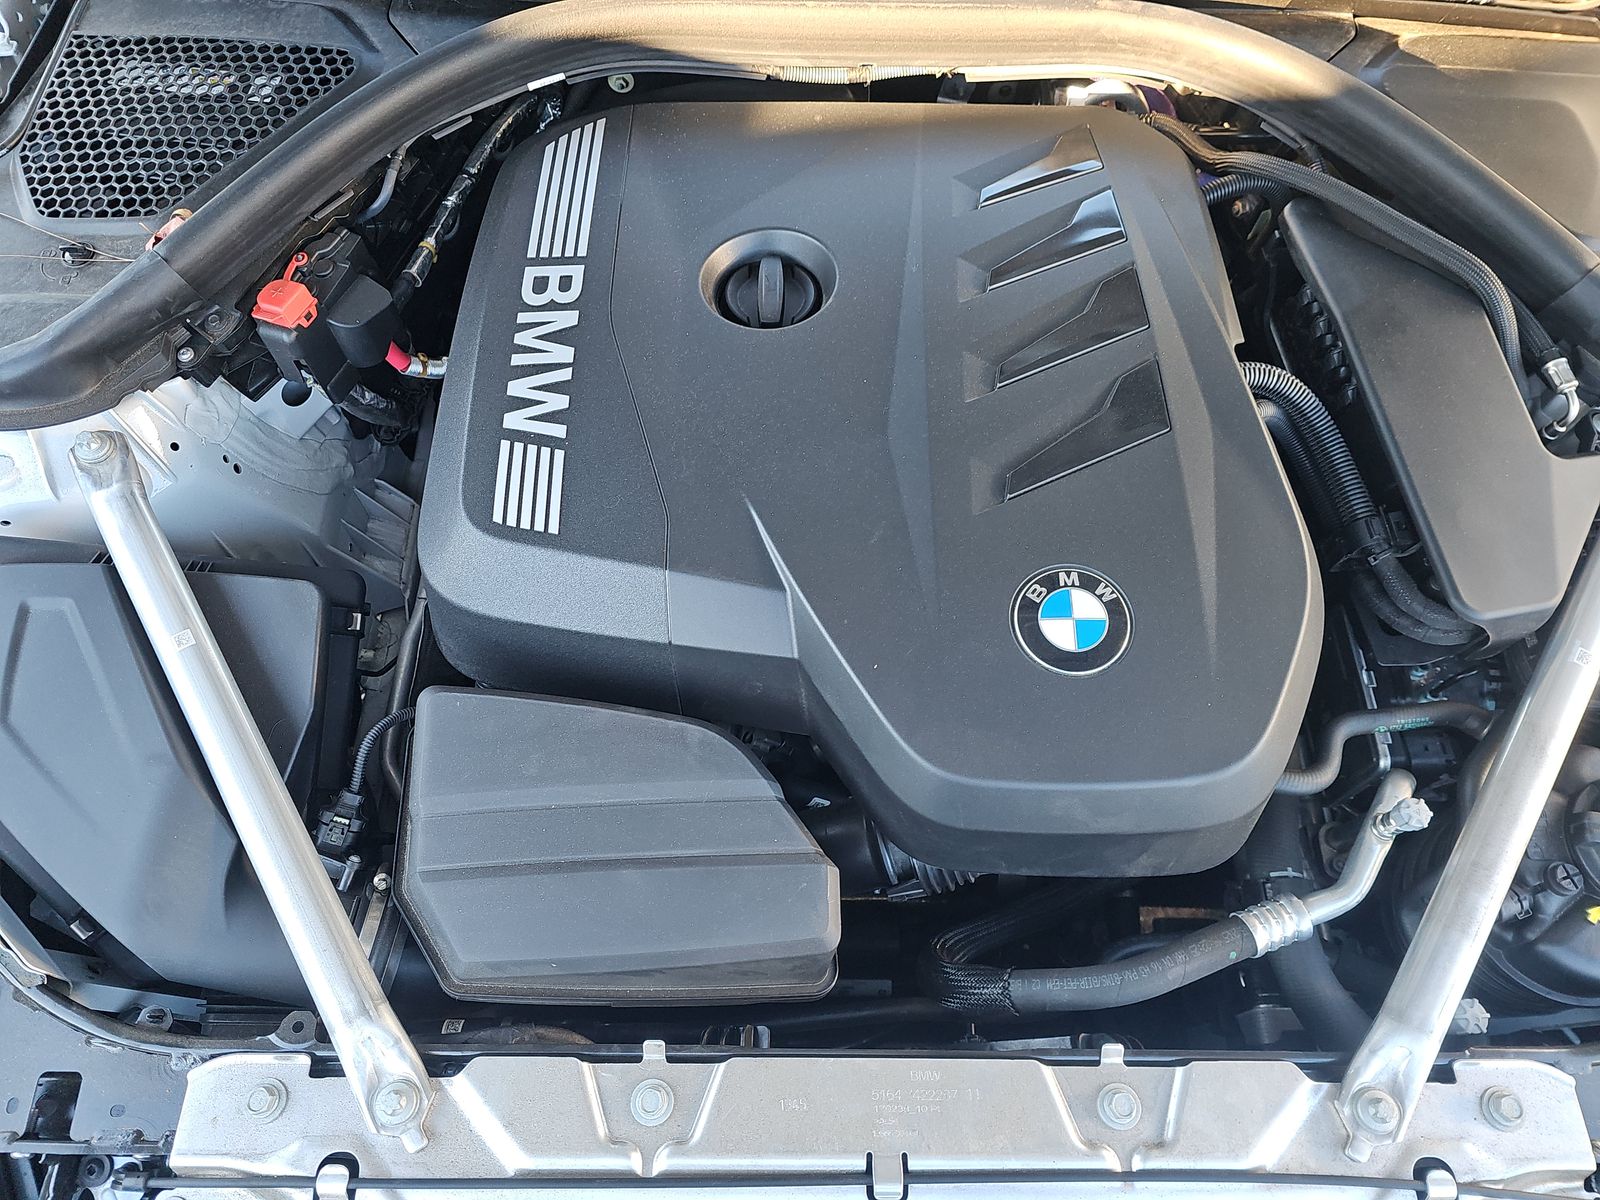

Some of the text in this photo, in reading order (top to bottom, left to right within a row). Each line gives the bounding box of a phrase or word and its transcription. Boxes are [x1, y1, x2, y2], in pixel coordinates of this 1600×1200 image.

[502, 265, 585, 439] BMW
[1025, 571, 1117, 604] BMW
[910, 1070, 941, 1081] BMW
